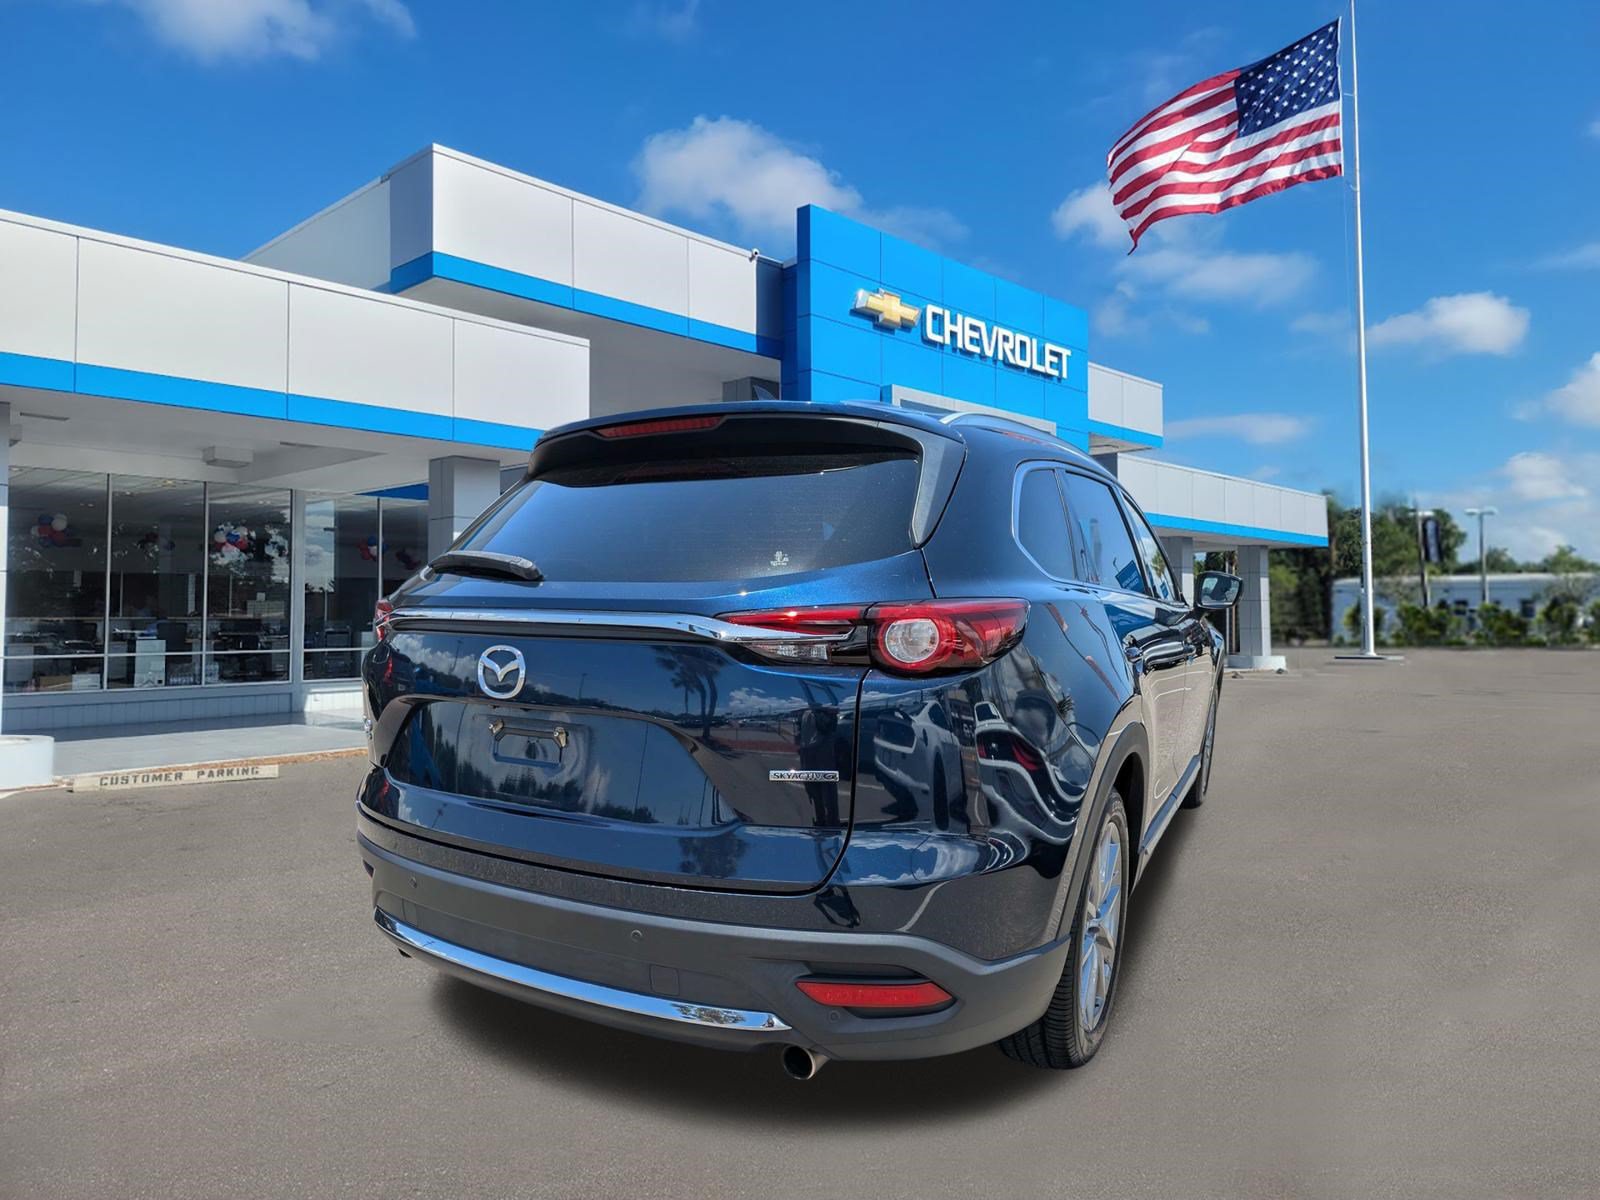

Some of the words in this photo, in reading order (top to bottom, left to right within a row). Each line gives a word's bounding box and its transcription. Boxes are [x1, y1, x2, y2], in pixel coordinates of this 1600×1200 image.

[926, 303, 1072, 379] CHEVROLET
[99, 772, 183, 787] CUSTOMER
[197, 766, 259, 779] PARKING
